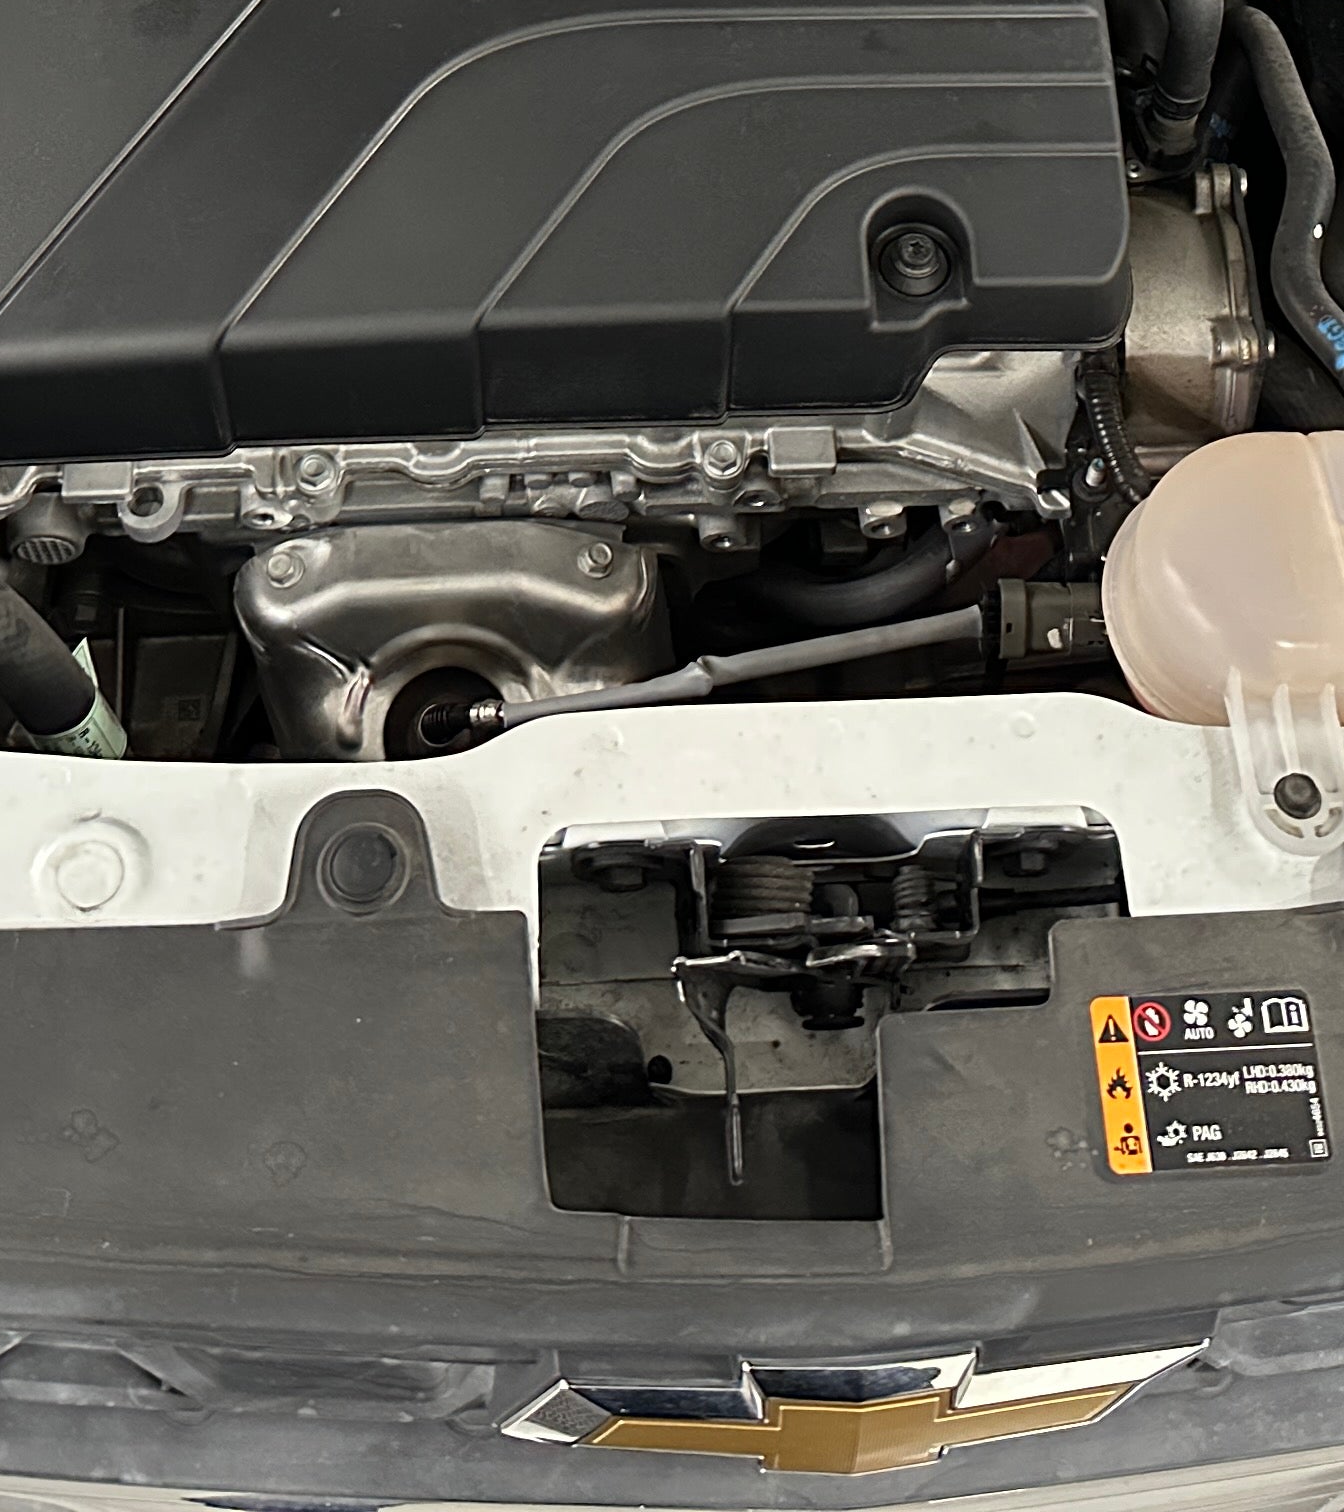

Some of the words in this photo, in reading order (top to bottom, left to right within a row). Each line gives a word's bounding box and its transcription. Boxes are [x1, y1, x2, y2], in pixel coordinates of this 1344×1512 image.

[1184, 1026, 1215, 1041] AUTO
[1182, 1071, 1241, 1090] R-1234yf
[1192, 1124, 1223, 1142] PAG
